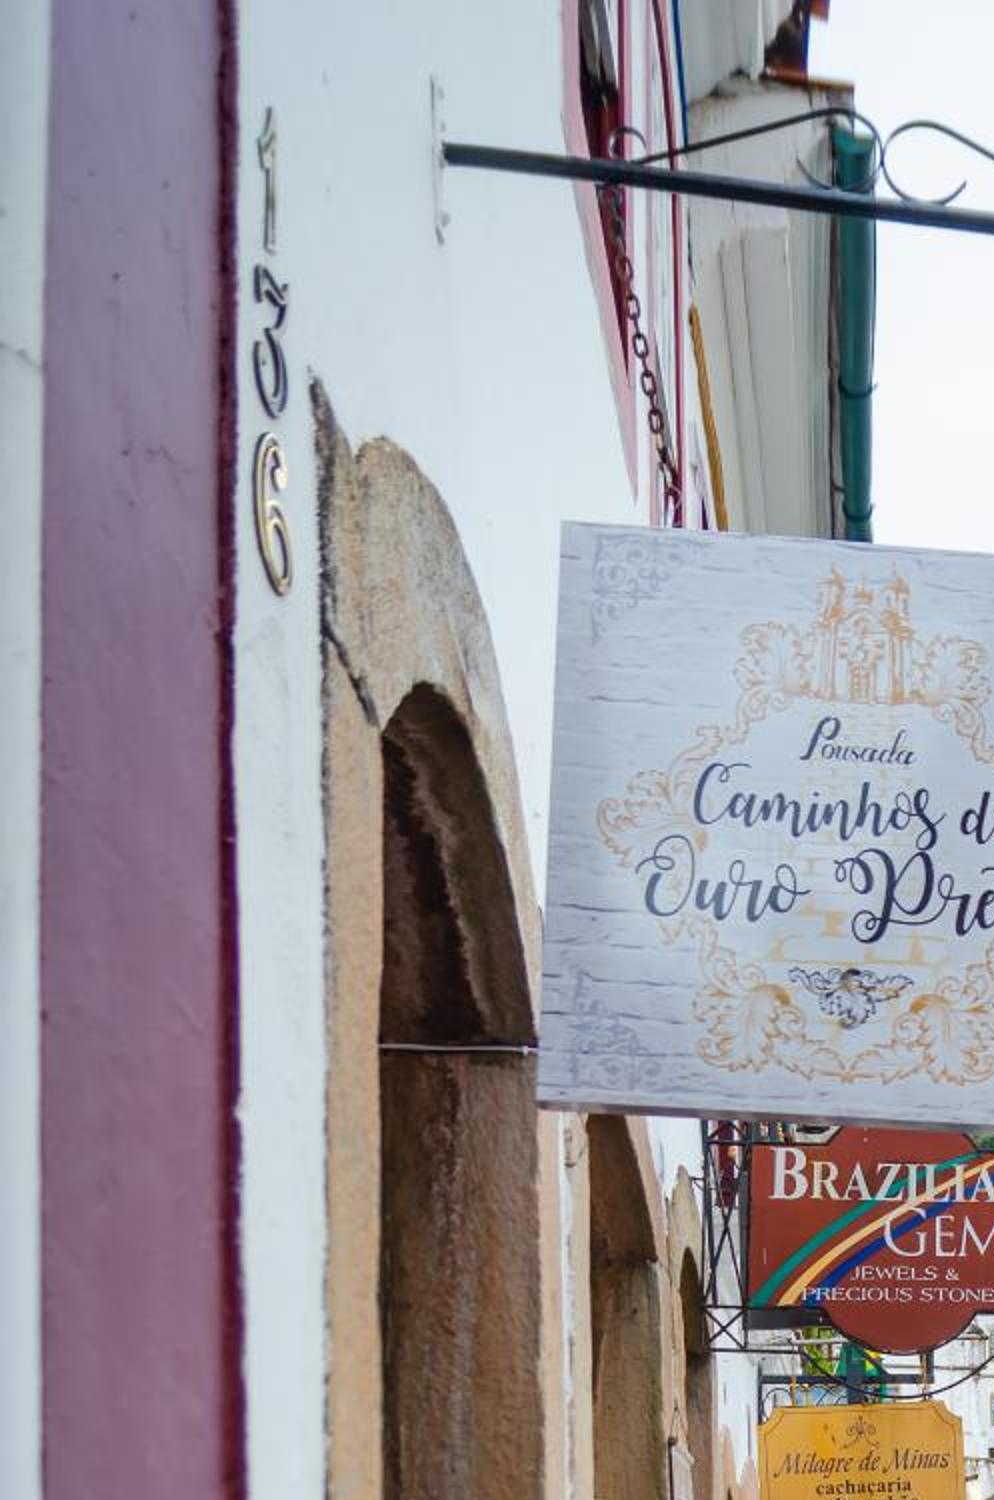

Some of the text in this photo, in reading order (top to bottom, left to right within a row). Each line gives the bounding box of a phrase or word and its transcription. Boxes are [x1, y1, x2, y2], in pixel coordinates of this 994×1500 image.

[800, 716, 915, 766] Pousada
[693, 762, 947, 852] Caminhos
[635, 833, 812, 920] Ouro
[849, 1265, 960, 1282] JEWELS &
[801, 1286, 913, 1302] PRECIOUS
[773, 1447, 952, 1479] Milagre de Minas
[815, 1477, 912, 1497] cachaçaria
